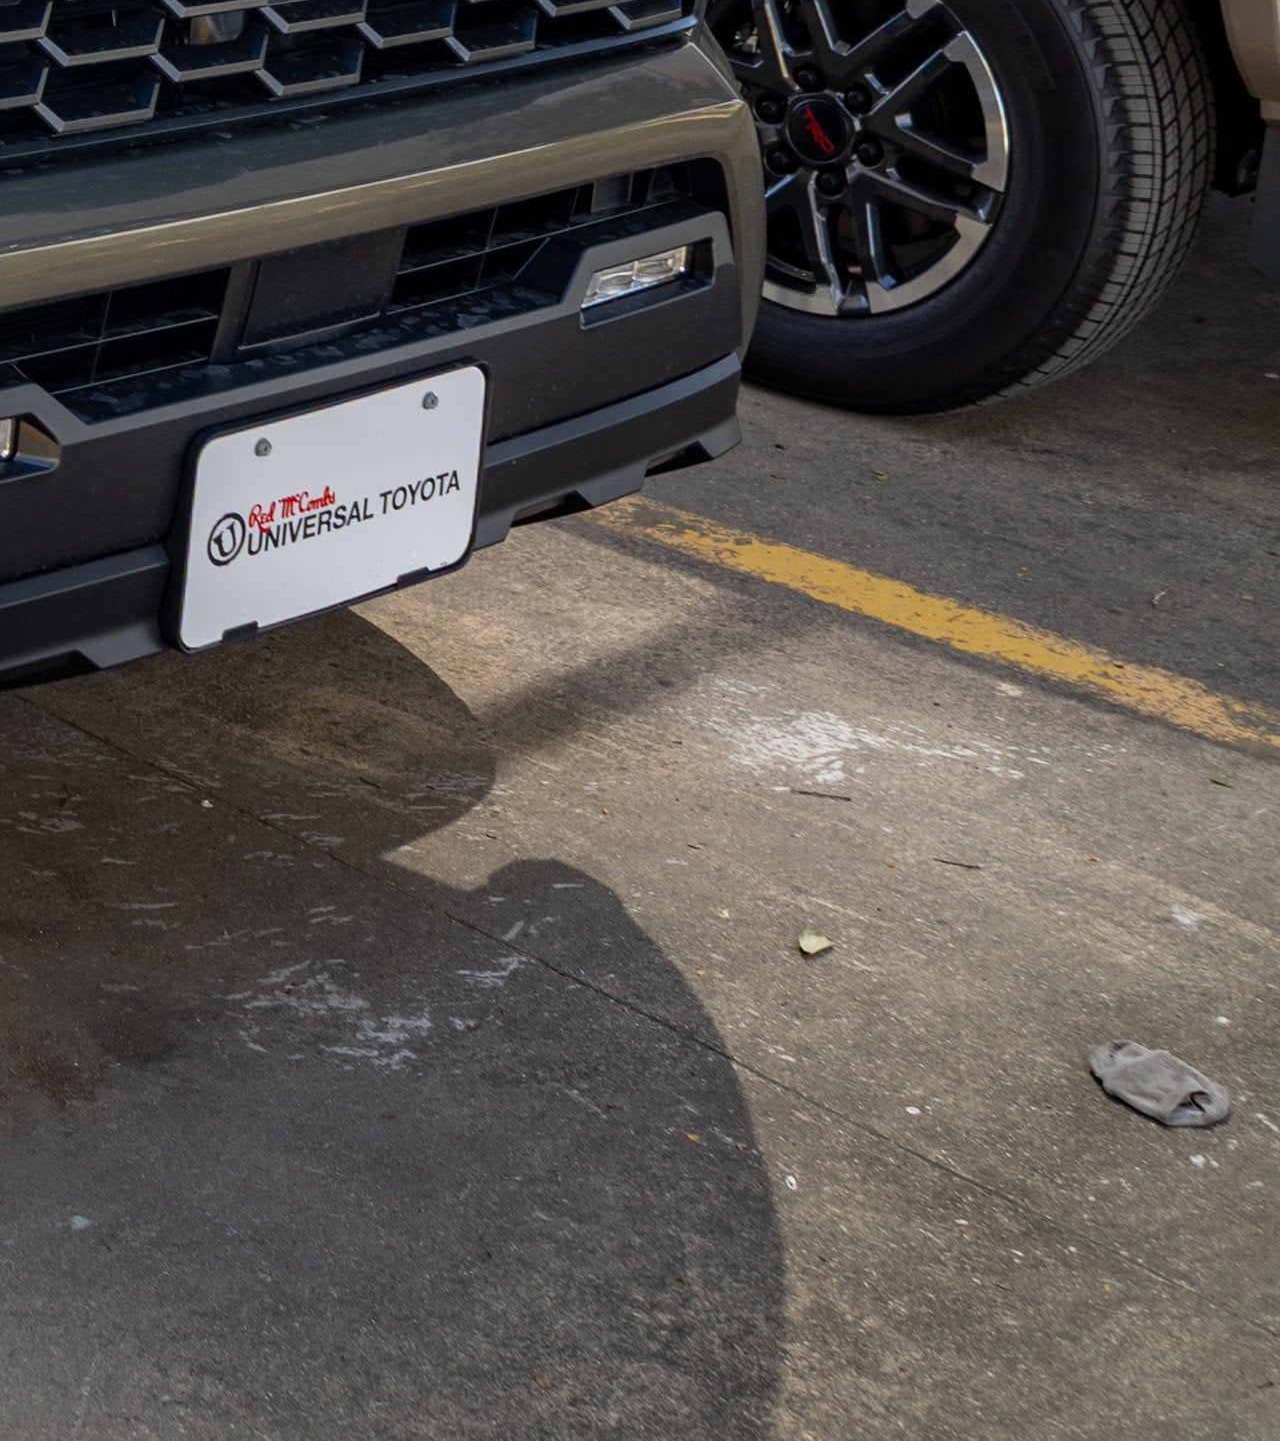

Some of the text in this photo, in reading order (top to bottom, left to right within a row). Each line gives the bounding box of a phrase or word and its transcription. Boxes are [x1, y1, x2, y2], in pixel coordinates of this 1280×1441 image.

[803, 105, 836, 153] TRD
[247, 470, 460, 556] UNIVERSAL TOYOTA
[248, 501, 276, 533] Red
